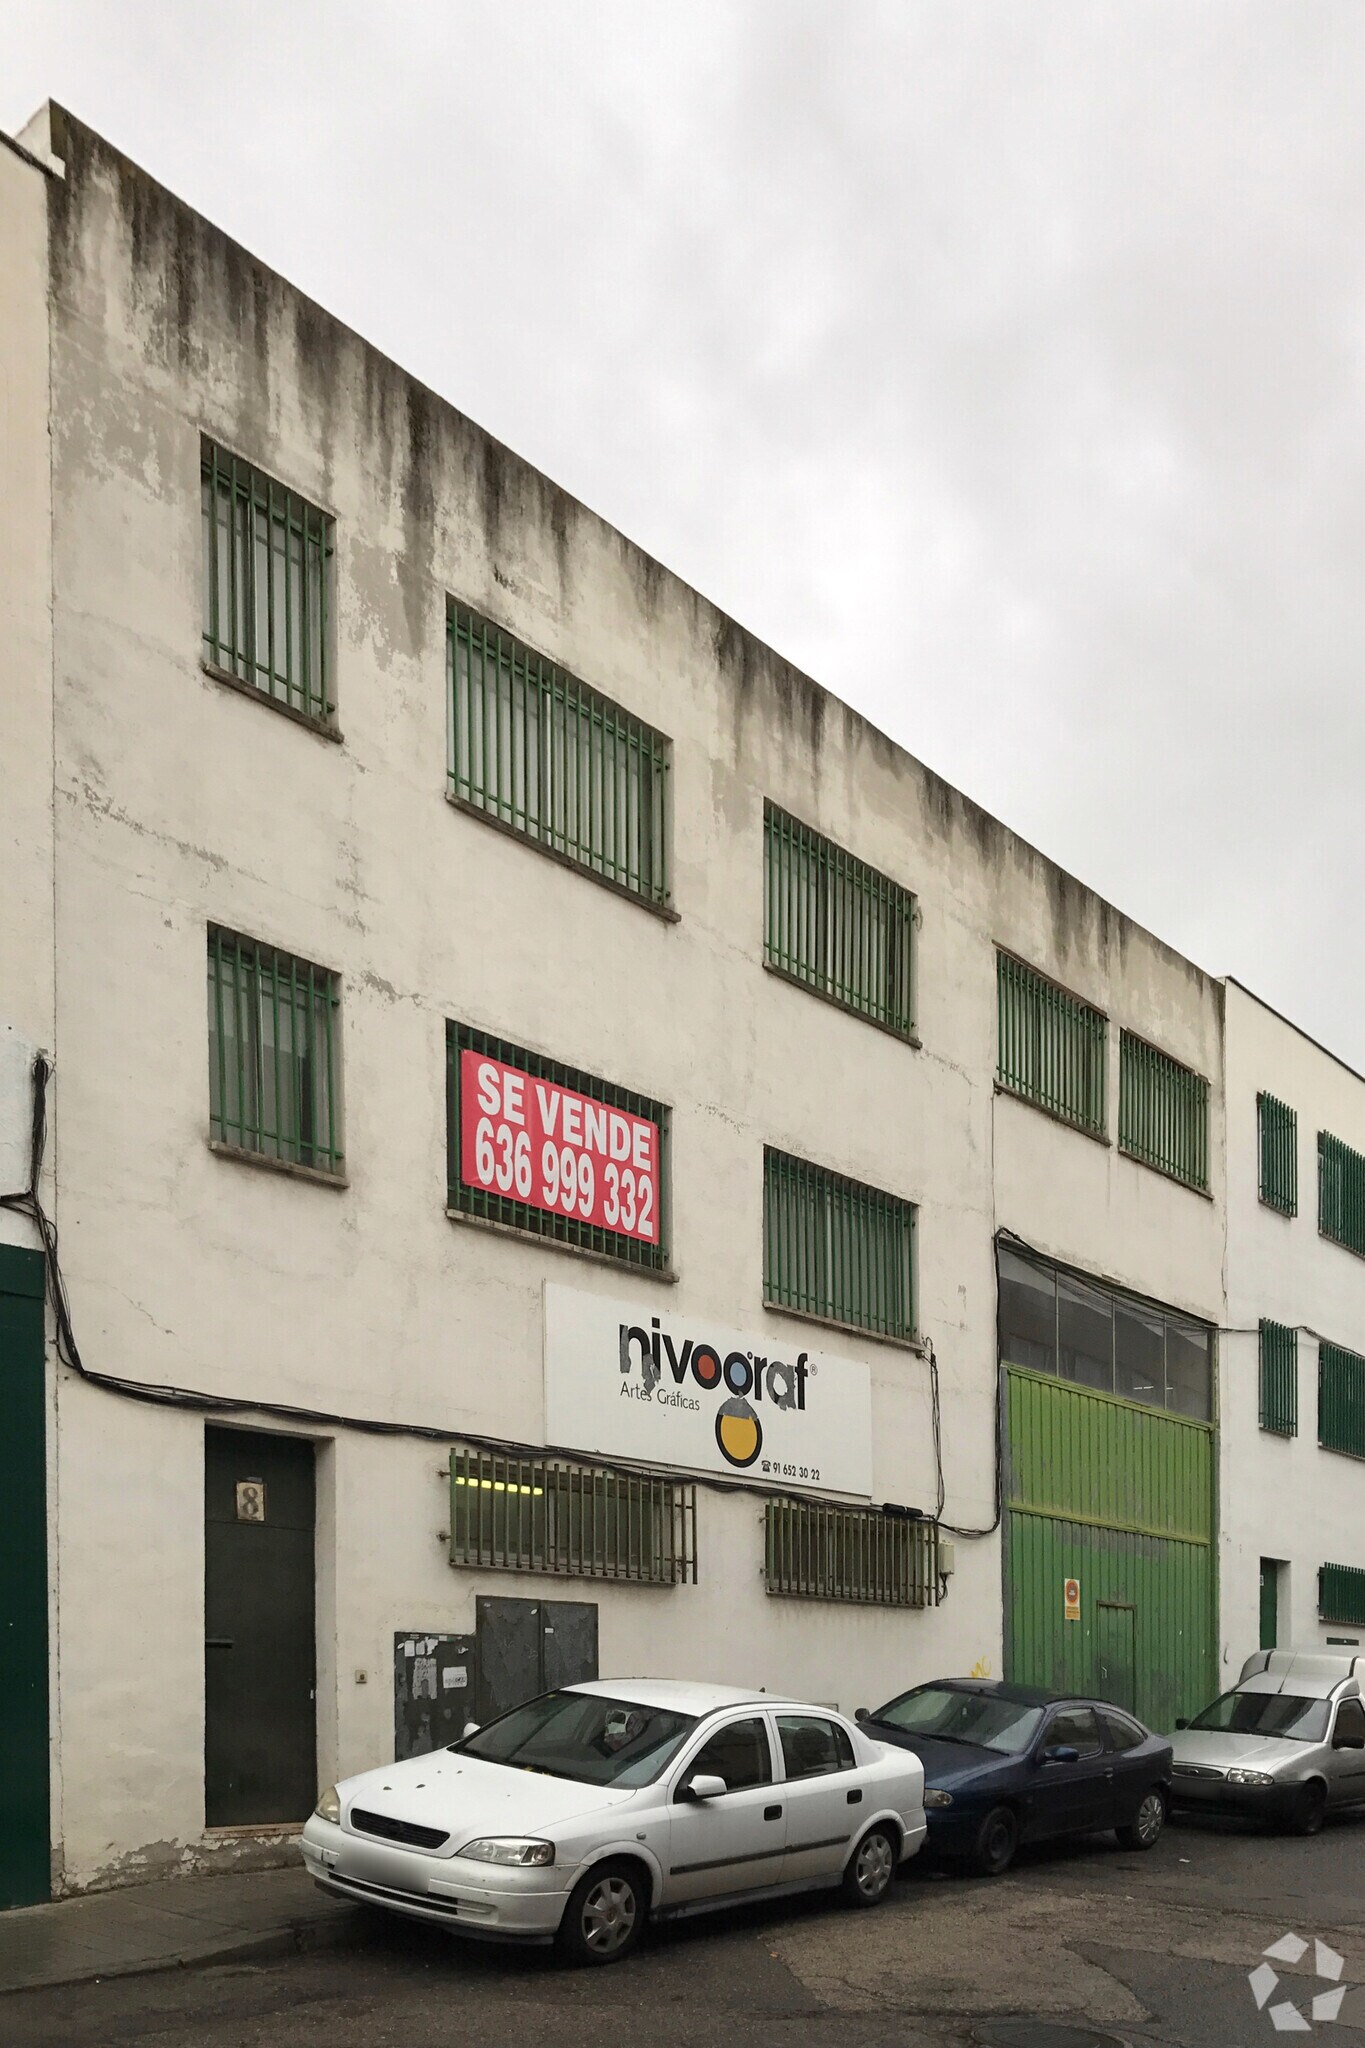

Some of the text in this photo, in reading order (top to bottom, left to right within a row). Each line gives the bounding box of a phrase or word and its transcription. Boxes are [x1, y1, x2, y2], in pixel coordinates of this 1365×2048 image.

[477, 1063, 651, 1172] SE VENDE
[475, 1117, 653, 1237] 636 999 332
[620, 1381, 700, 1411] Artes Gráficas
[772, 1462, 820, 1480] 91 652 30 22
[242, 1486, 259, 1516] 8
